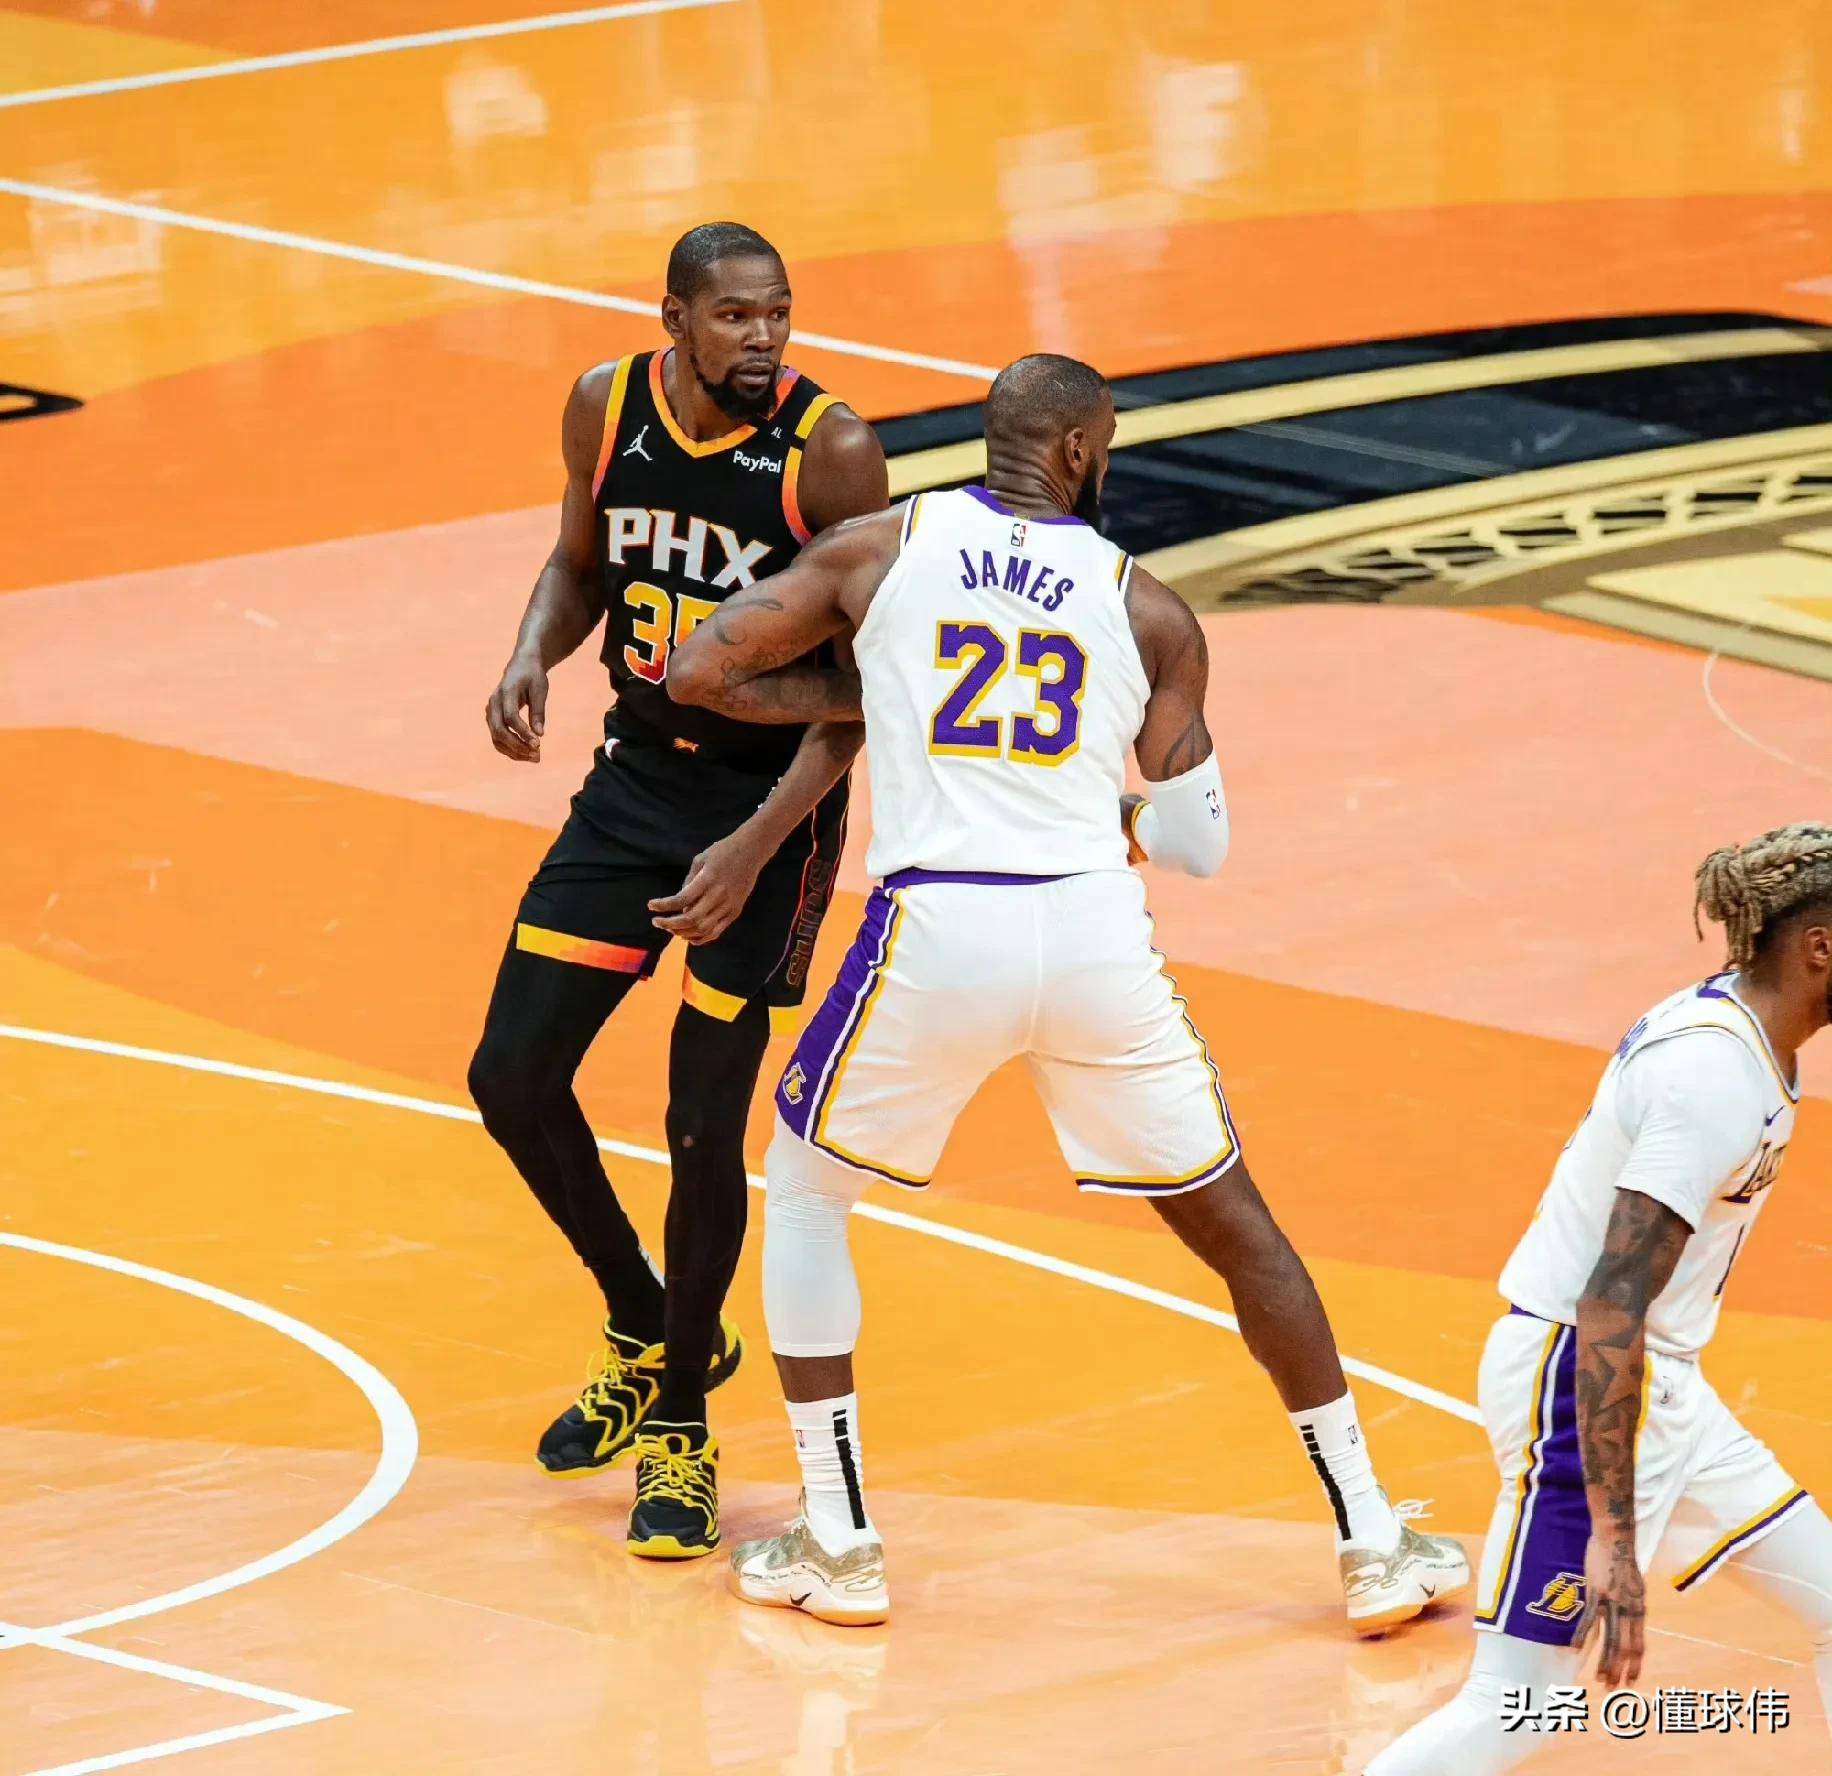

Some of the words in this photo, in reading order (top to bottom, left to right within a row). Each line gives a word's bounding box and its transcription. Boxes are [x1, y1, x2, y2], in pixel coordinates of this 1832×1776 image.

[733, 450, 782, 473] PayPal
[770, 426, 782, 439] AL
[604, 507, 774, 589] PHX
[959, 548, 1074, 612] JAMES
[928, 619, 1089, 768] 23
